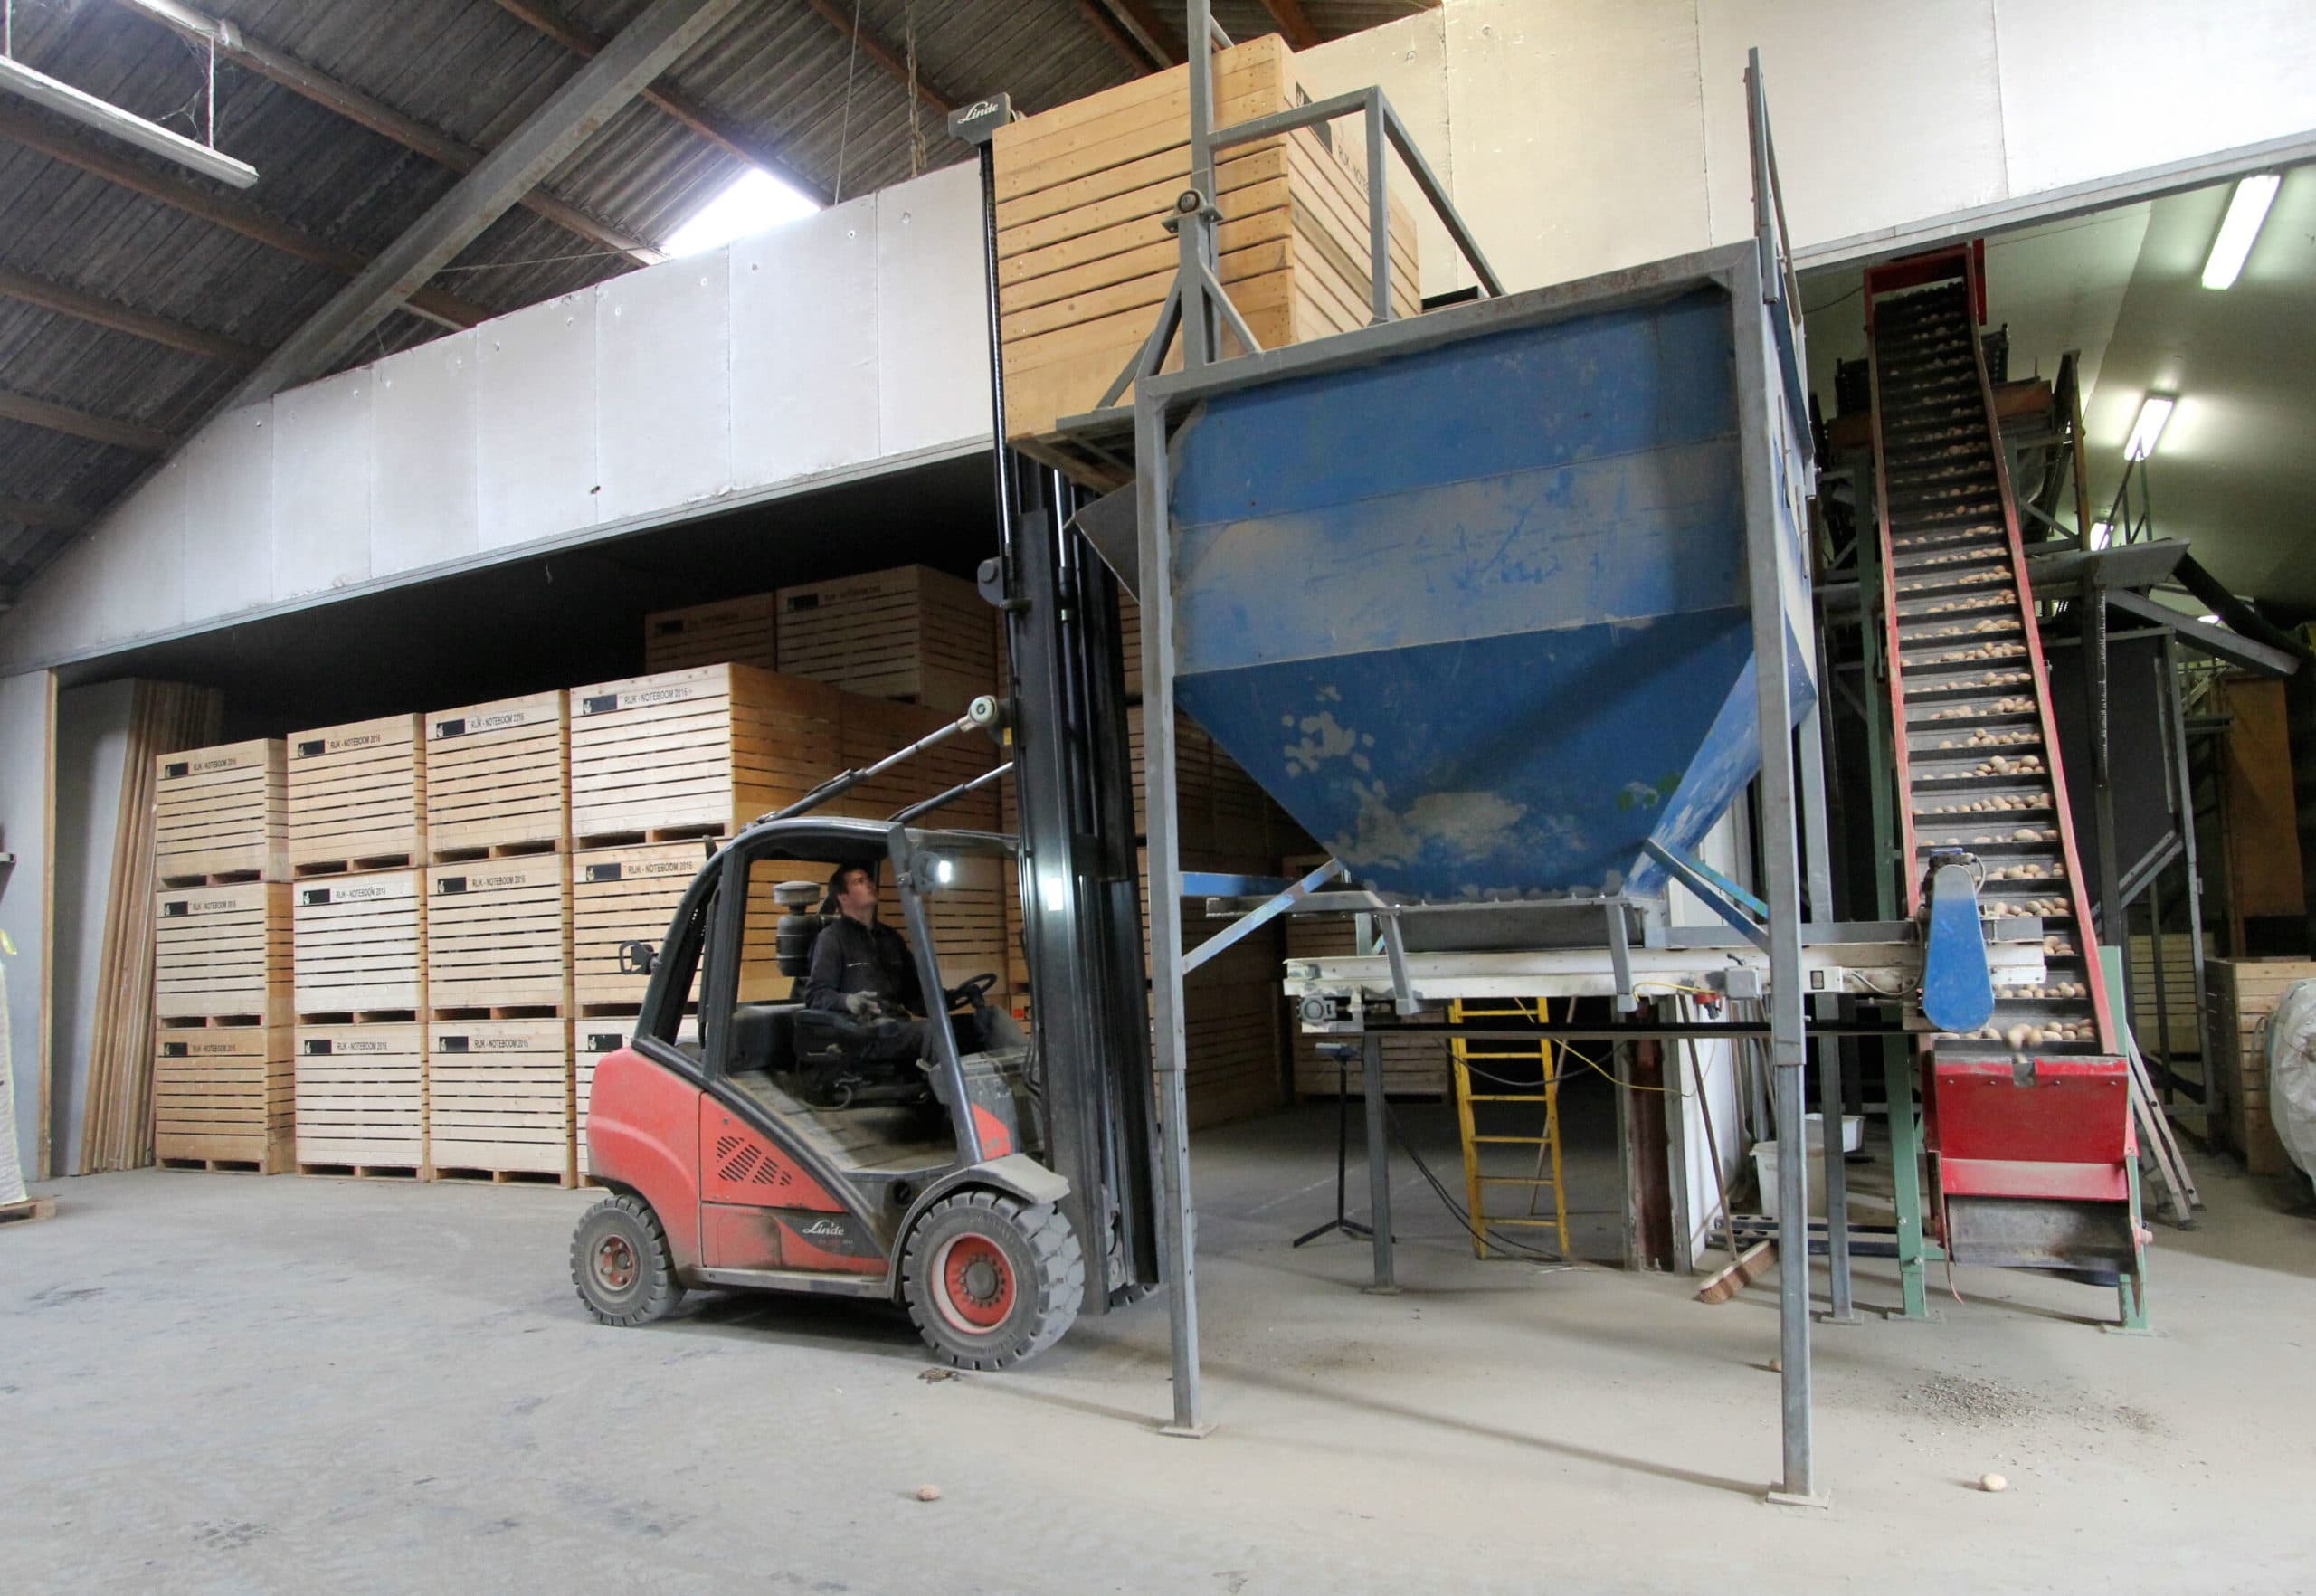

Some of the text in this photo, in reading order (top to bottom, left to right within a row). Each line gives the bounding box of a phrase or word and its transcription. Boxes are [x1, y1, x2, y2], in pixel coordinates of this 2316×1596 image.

[957, 101, 999, 124] Linde
[645, 861, 679, 873] NOTEBOOM
[802, 1219, 845, 1236] Linde
